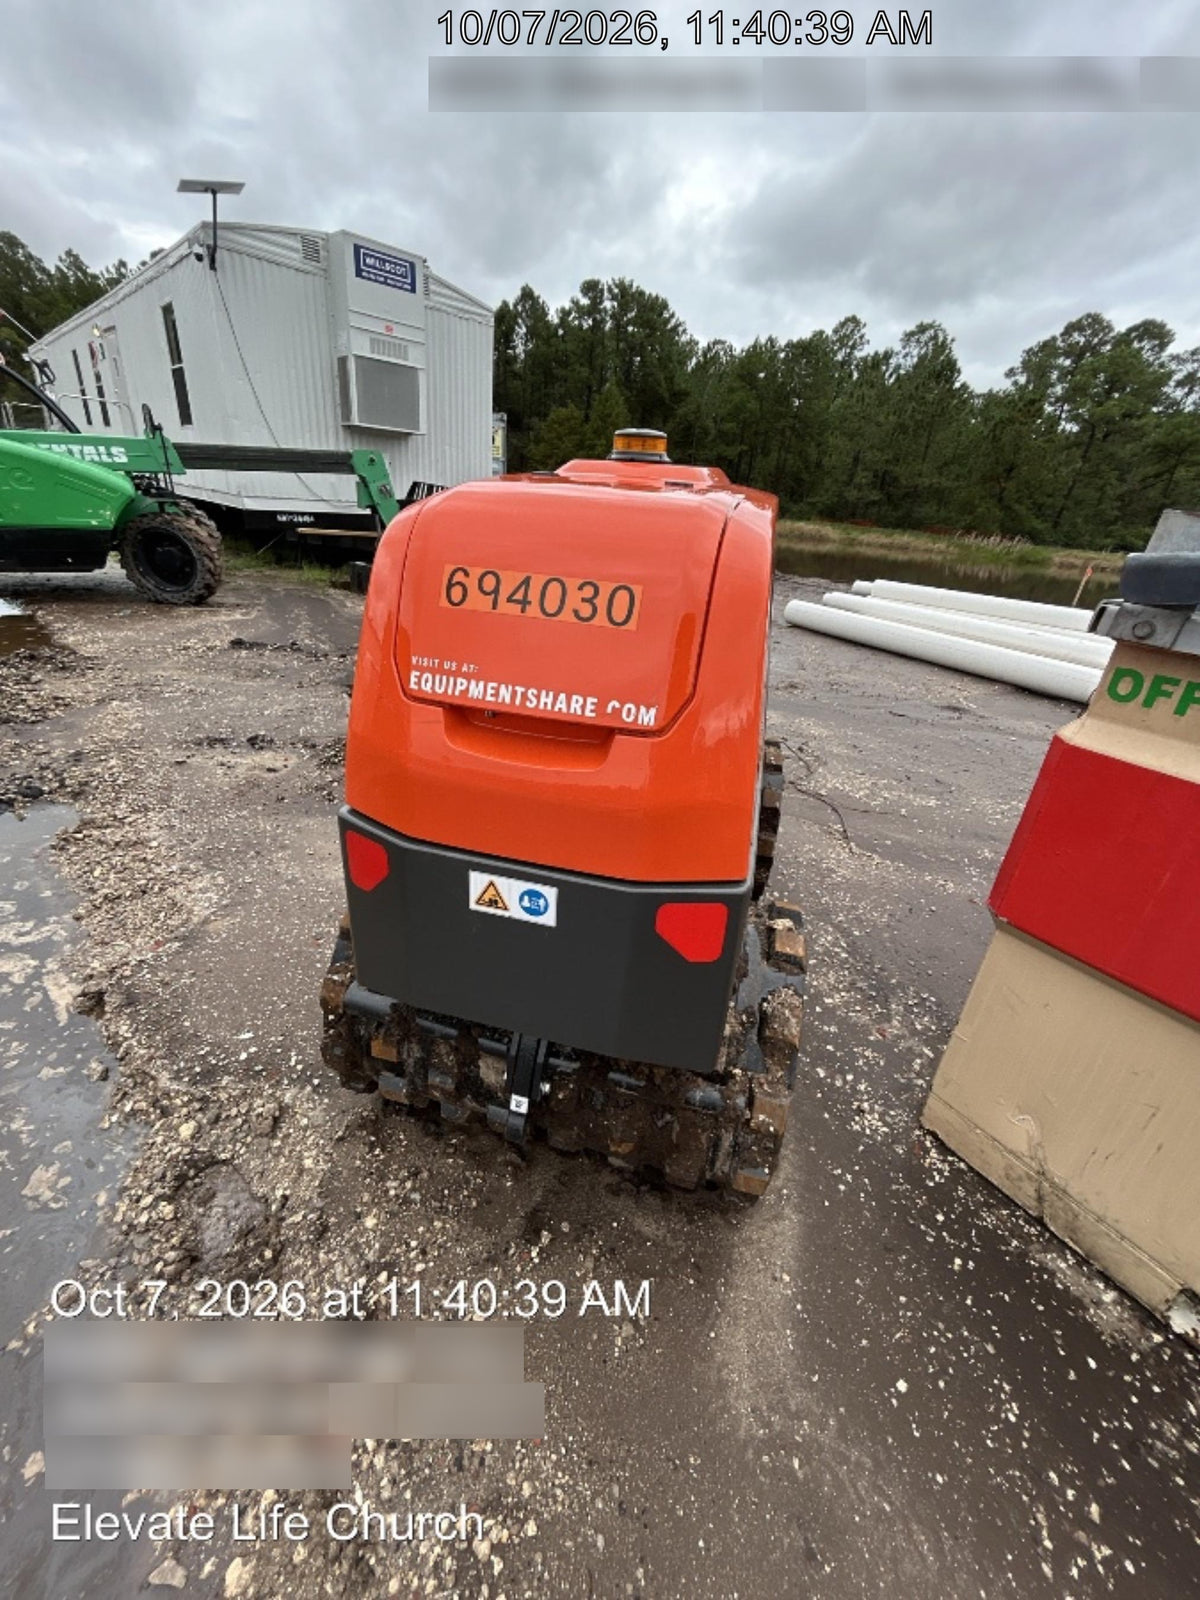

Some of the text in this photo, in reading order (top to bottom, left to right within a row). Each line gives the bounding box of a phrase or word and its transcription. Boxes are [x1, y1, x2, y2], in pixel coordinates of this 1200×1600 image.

[27, 443, 128, 463] NTALS
[445, 566, 636, 627] 694030
[411, 655, 479, 673] VISIT US AT:
